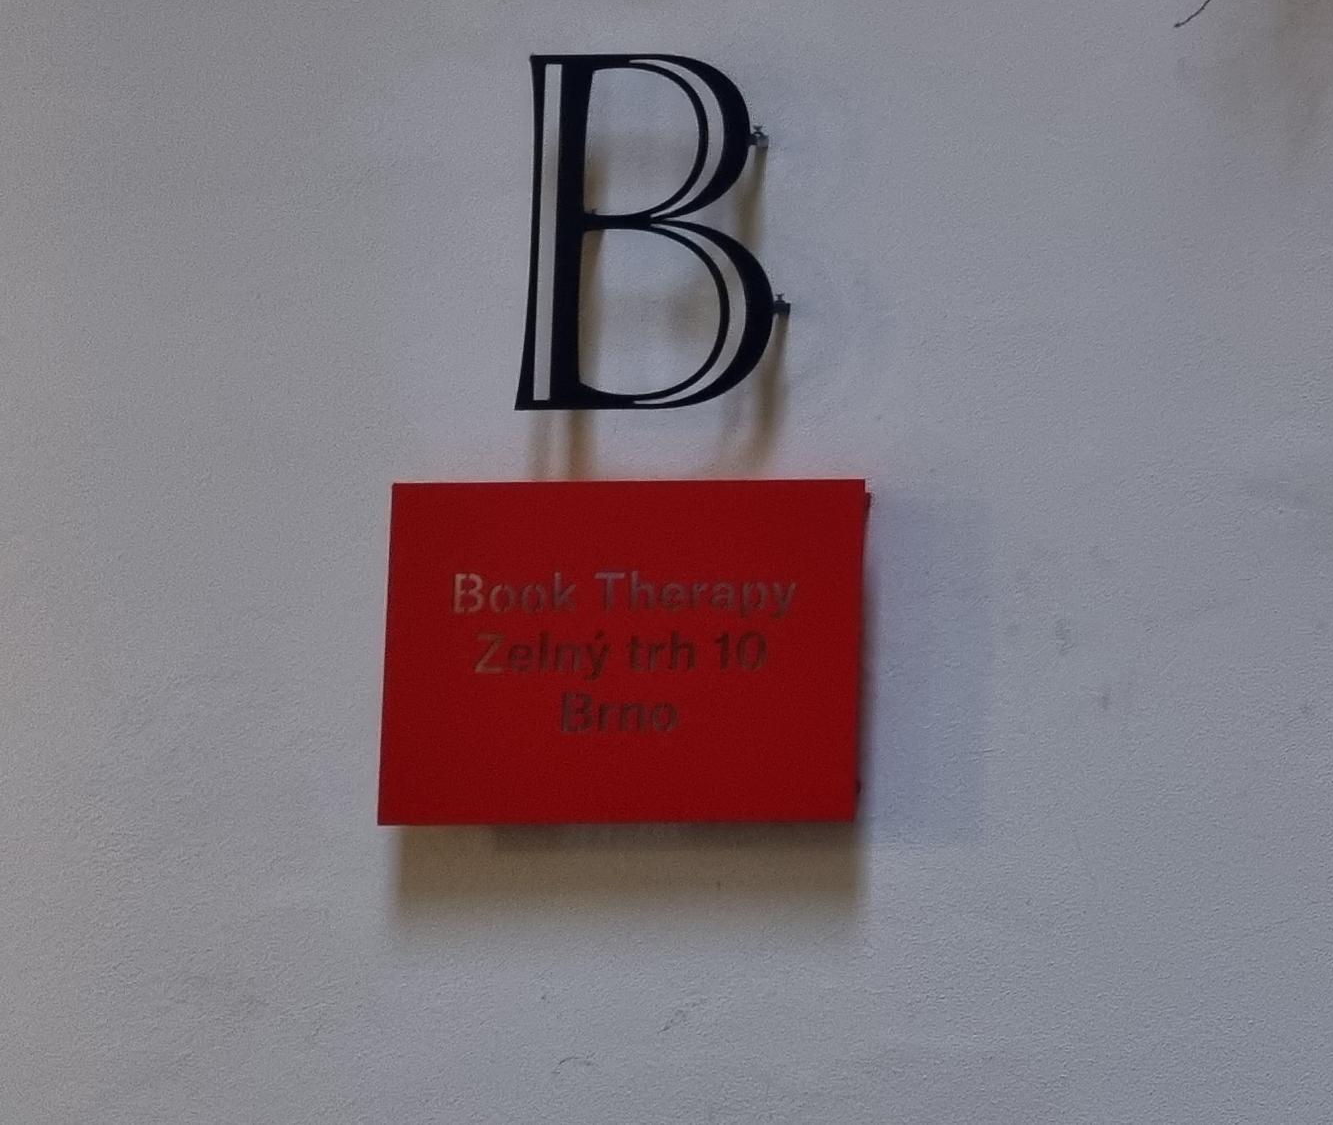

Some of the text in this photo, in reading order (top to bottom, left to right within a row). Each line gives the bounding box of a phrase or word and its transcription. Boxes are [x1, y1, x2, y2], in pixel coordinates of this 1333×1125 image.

[514, 53, 775, 411] B
[453, 570, 797, 620] Book Therapy
[474, 629, 769, 681] Zelný trh 10
[561, 690, 681, 734] Brno
